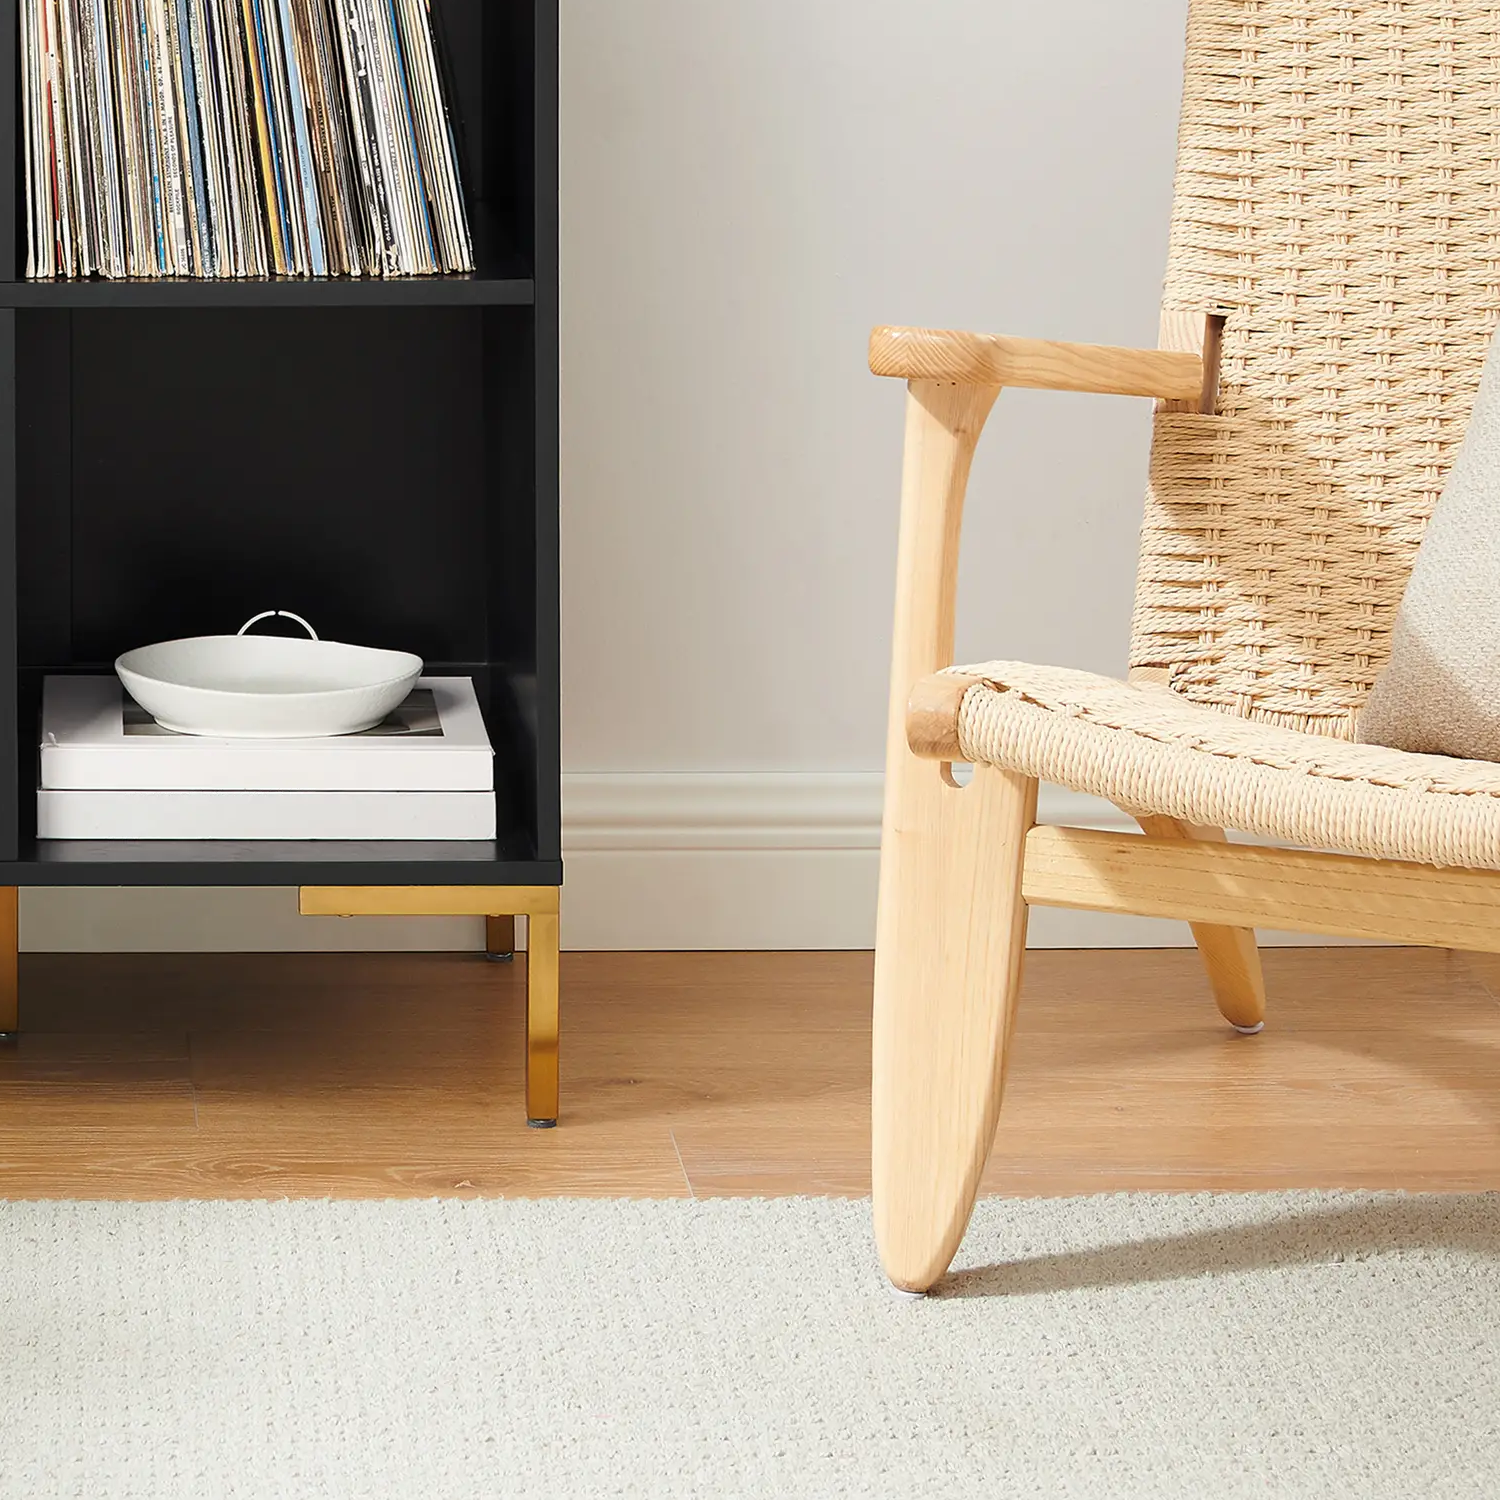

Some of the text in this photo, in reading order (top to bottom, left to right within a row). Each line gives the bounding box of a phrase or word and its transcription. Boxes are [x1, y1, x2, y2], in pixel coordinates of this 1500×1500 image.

[166, 115, 175, 144] PLEASURE
[169, 144, 175, 152] OF
[170, 152, 178, 178] SECONDS
[173, 188, 182, 215] ROCKPILE
